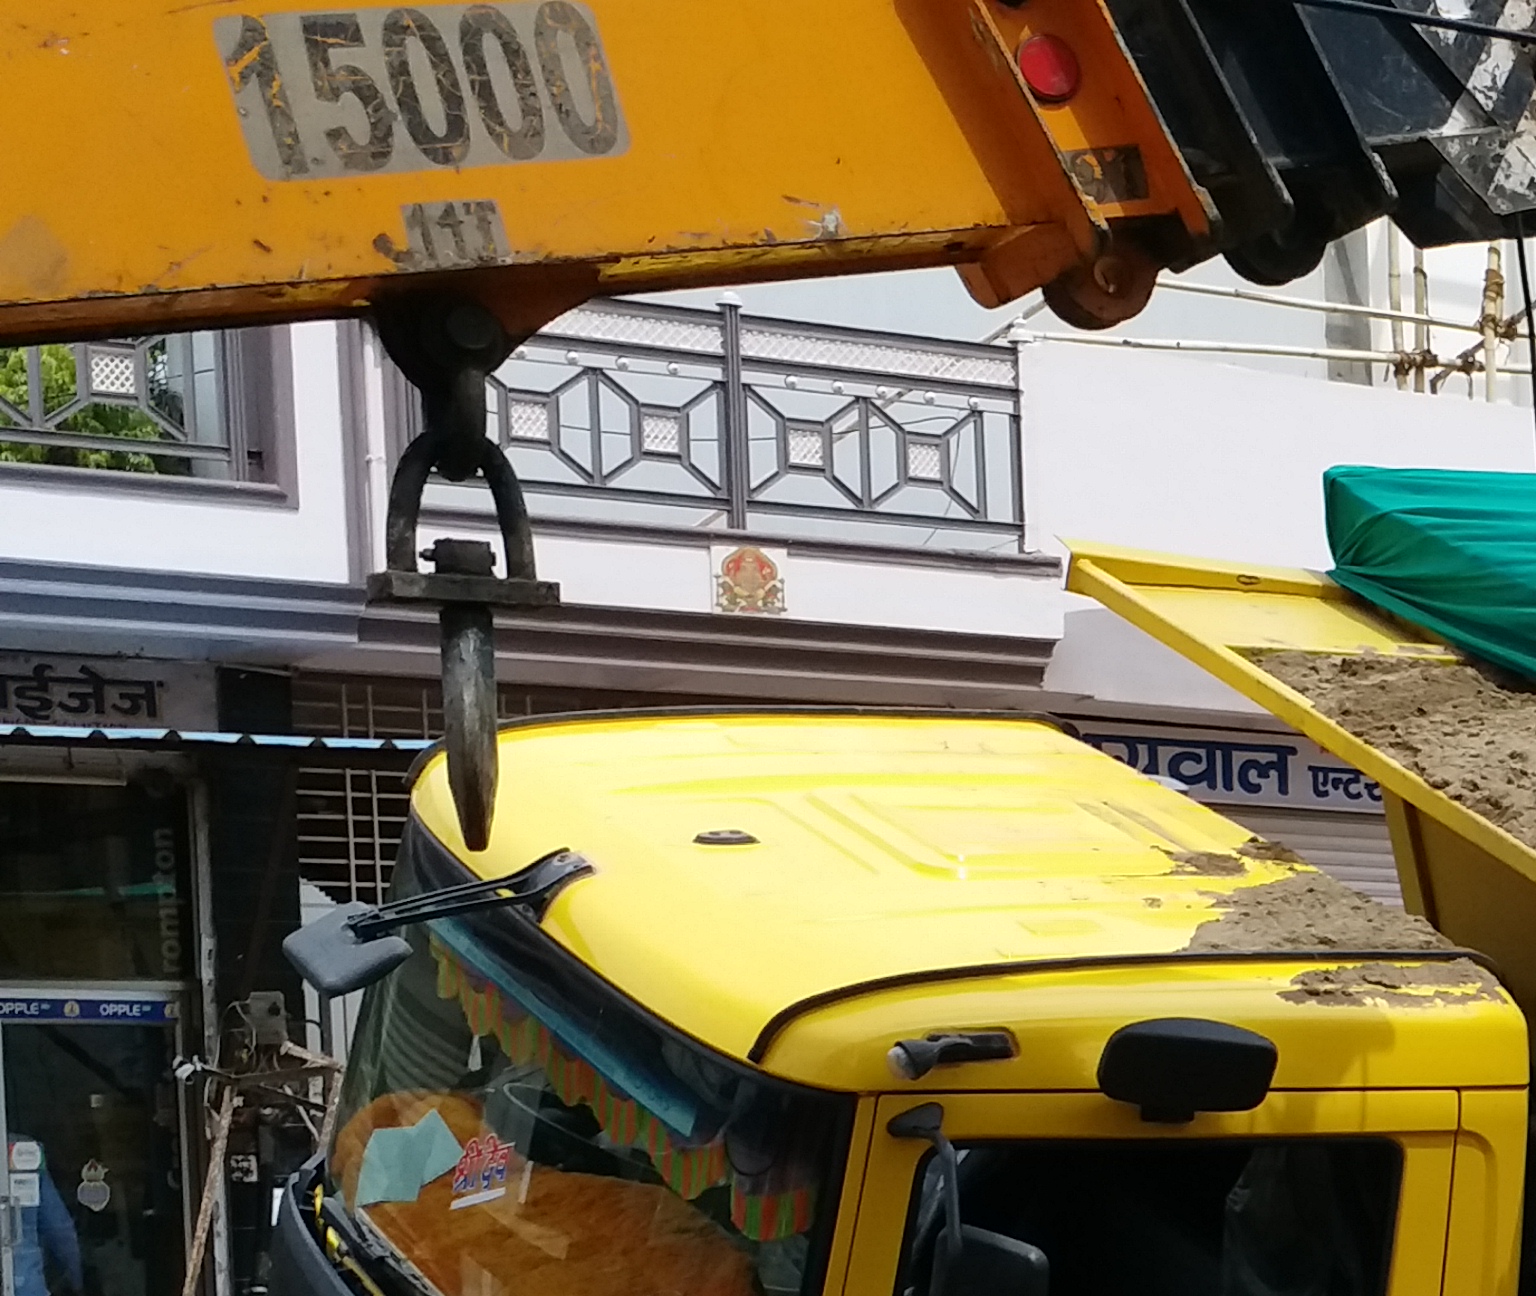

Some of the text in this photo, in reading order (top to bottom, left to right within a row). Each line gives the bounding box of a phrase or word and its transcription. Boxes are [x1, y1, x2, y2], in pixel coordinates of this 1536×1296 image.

[229, 1, 619, 175] 15000
[1082, 734, 1297, 796] ग्रवाल
[100, 1003, 141, 1016] OPPLE
